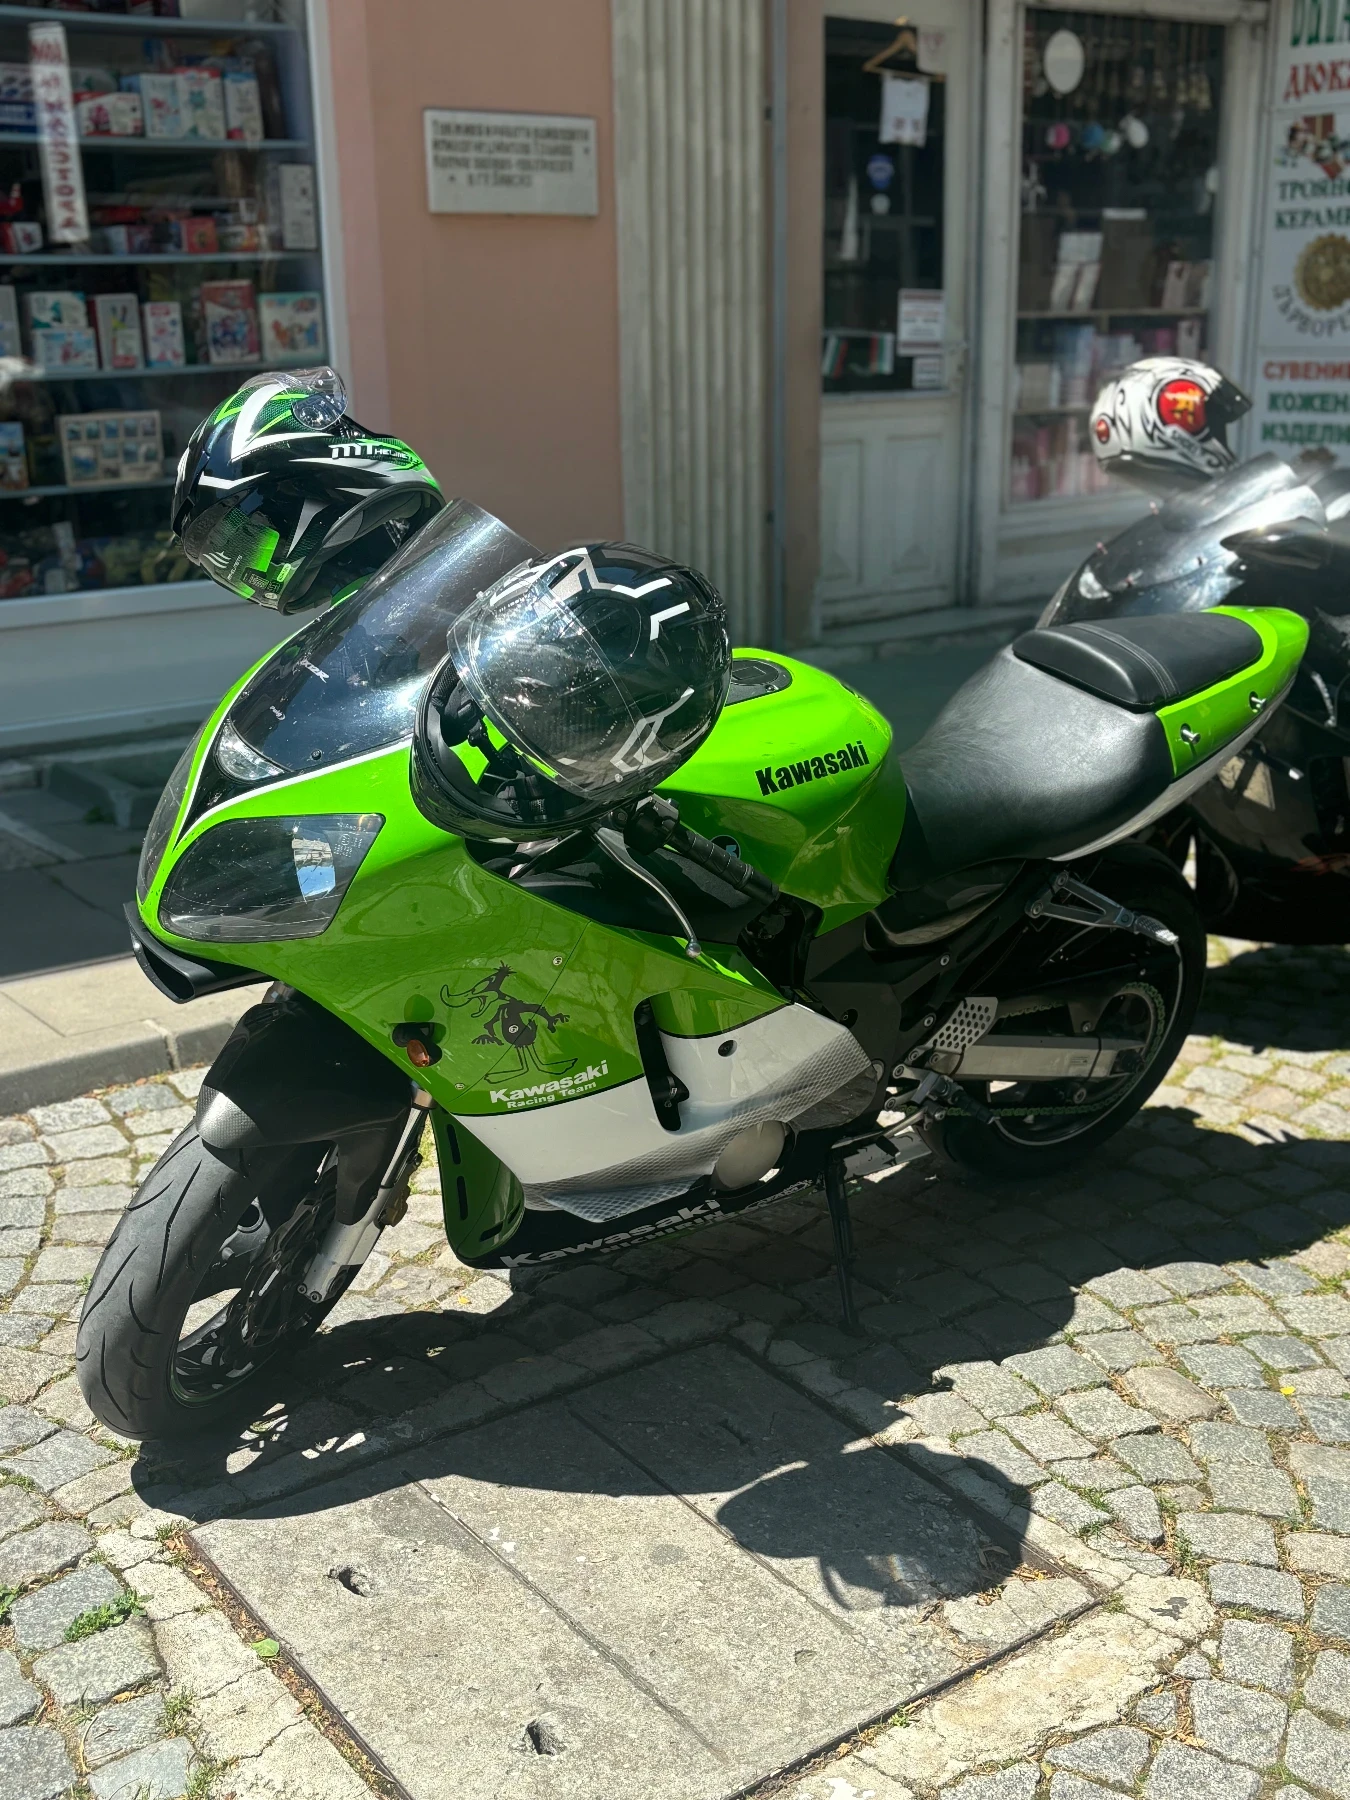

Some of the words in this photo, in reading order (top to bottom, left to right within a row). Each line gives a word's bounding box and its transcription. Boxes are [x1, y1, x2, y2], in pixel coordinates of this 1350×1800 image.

[755, 740, 870, 796] Kawasaki
[489, 1059, 609, 1103] Kawasaki
[507, 1094, 556, 1109] Racing
[559, 1081, 597, 1097] Team
[500, 1199, 721, 1268] Kawasaki
